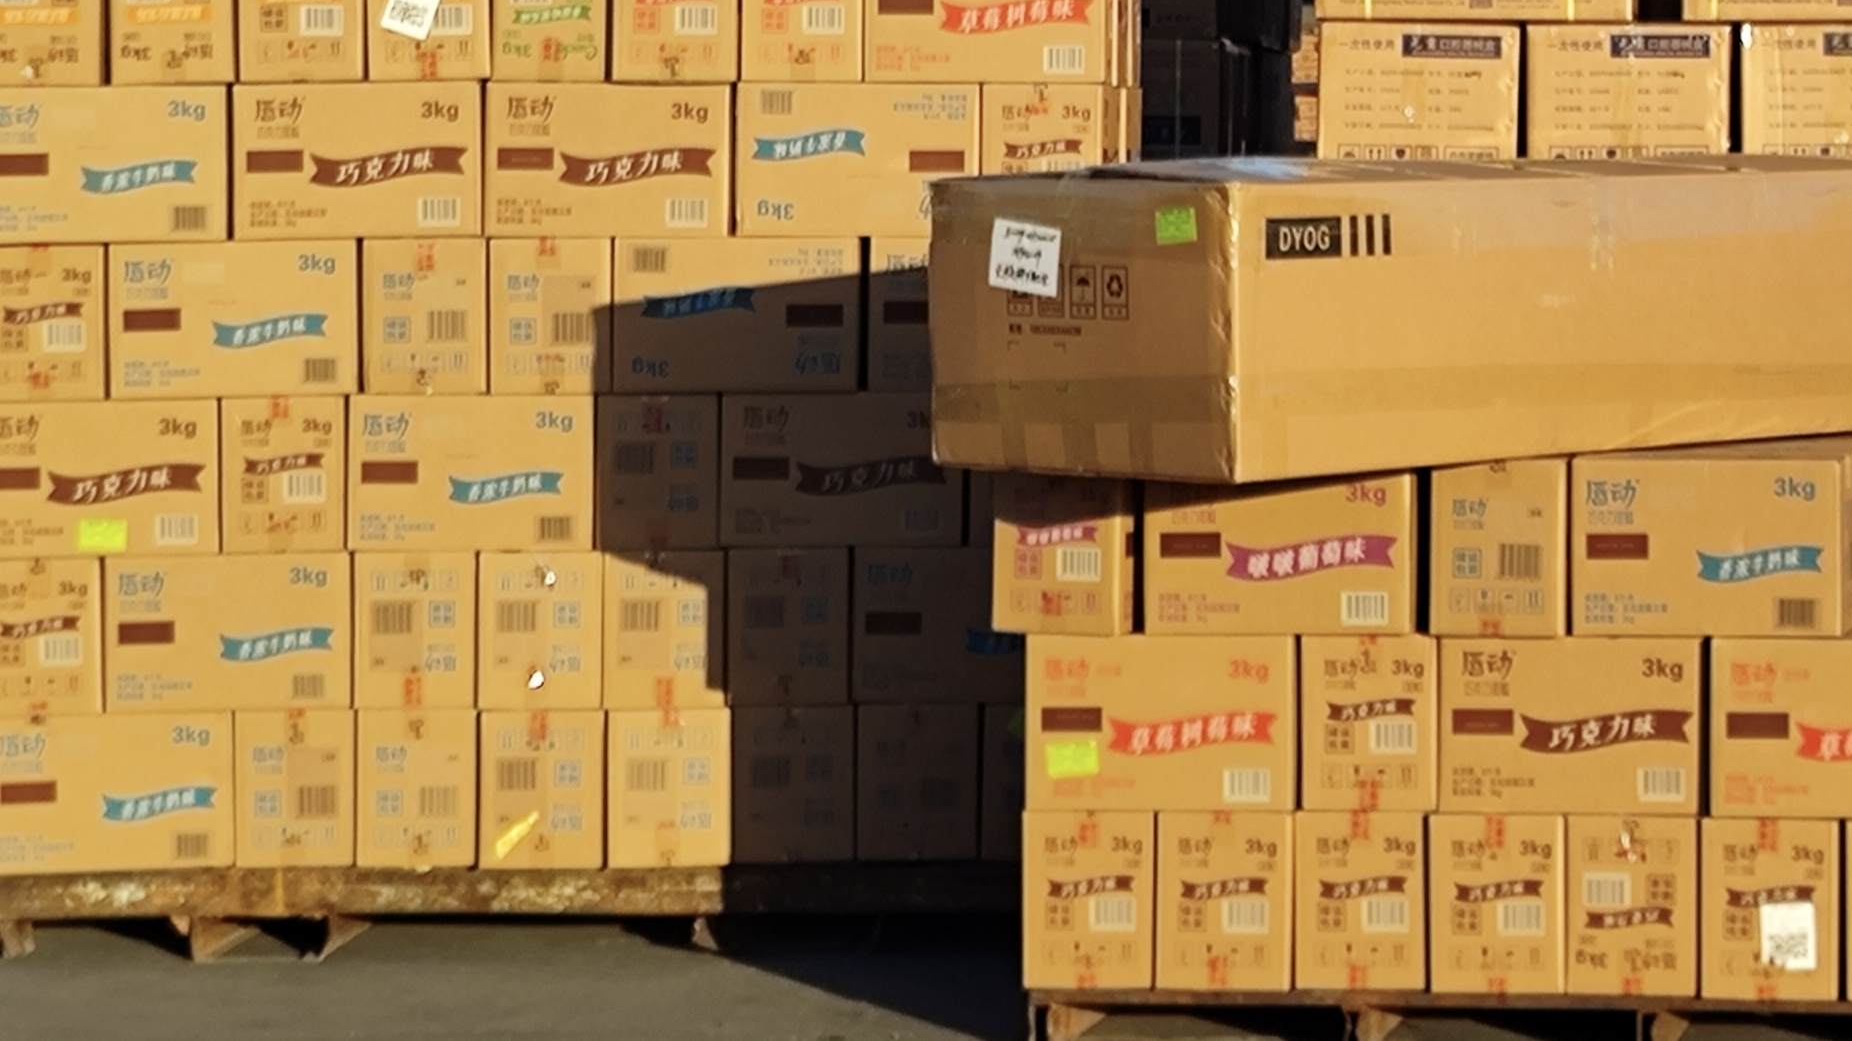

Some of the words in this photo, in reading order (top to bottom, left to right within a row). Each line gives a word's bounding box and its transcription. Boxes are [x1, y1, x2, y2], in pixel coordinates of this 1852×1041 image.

[168, 100, 206, 122] 3kg
[421, 101, 459, 122] 3kg
[671, 102, 709, 124] 3kg
[1061, 104, 1092, 123] 3kg
[336, 149, 434, 185] 巧克力味
[584, 150, 684, 184] 巧克力味
[1278, 225, 1331, 252] DYOG
[298, 254, 336, 275] 3kg
[61, 267, 92, 285] 3kg
[159, 417, 197, 438] 3kg
[301, 417, 332, 436] 3kg
[535, 410, 573, 432] 3kg
[907, 412, 931, 431] 3k
[72, 468, 172, 504] 巧克力味
[1345, 483, 1387, 506] 3kg
[1774, 476, 1816, 502] 3kg
[289, 567, 327, 588] 3kg
[58, 580, 89, 598] 3kg
[1229, 659, 1270, 684] 3kg
[1392, 659, 1424, 679] 3kg
[1641, 658, 1684, 682] 3kg
[172, 726, 210, 747] 3kg
[1131, 714, 1257, 755] 草莓树莓味
[1549, 712, 1657, 753] 巧克力味
[1111, 836, 1143, 856] 3kg
[1245, 837, 1277, 857] 3kg
[1383, 836, 1416, 856] 3kg
[1520, 840, 1553, 860] 3kg
[1791, 844, 1825, 864] 3kg
